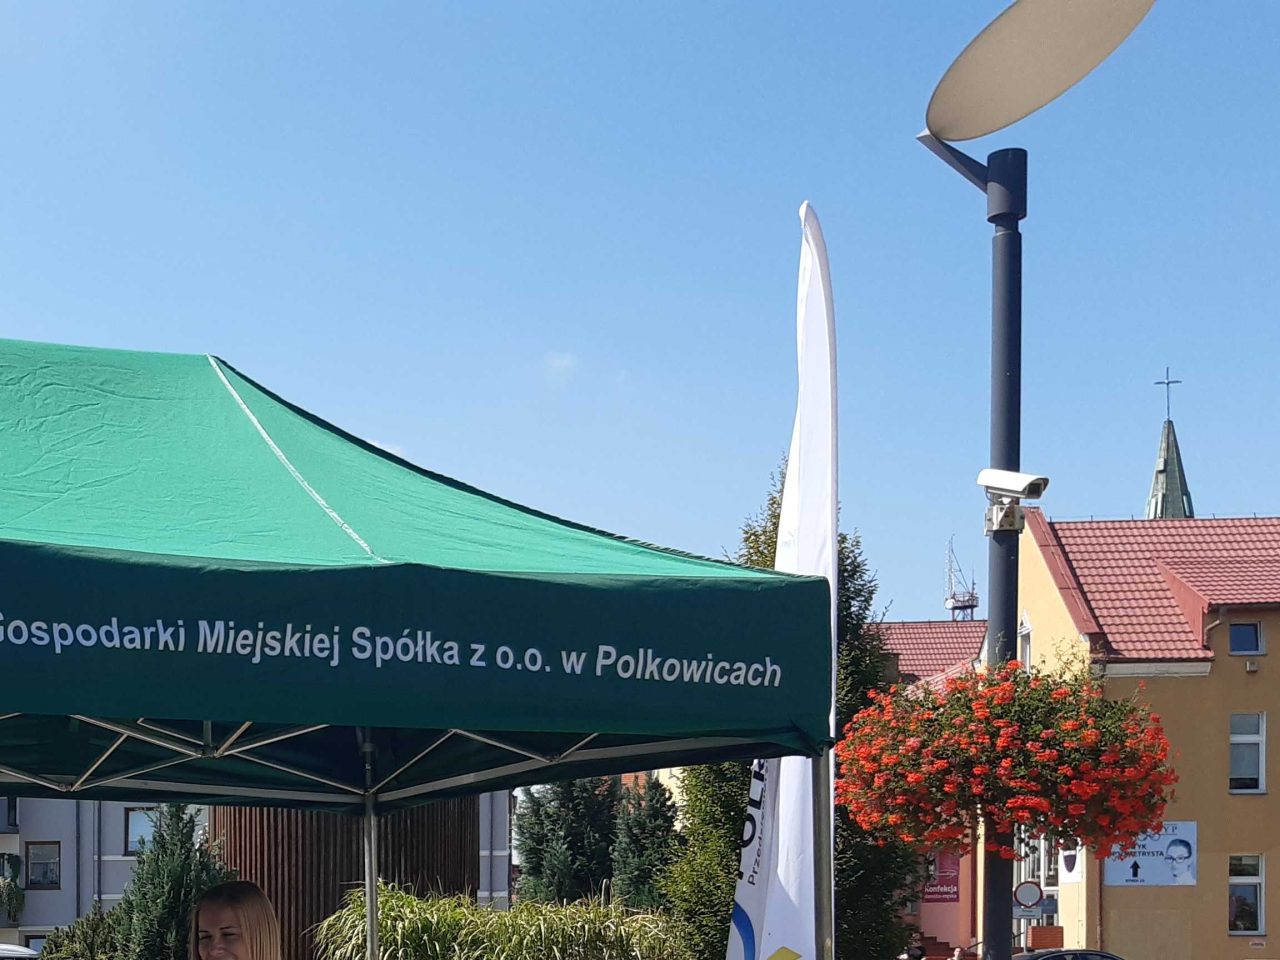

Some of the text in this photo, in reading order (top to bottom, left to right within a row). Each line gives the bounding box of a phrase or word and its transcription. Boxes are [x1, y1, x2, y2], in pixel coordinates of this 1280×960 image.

[197, 620, 340, 667] Miejskiej
[351, 626, 460, 668] Spółka
[470, 643, 486, 667] z
[495, 645, 551, 673] o.o.
[561, 649, 587, 675] w
[595, 644, 782, 688] Polkowicach
